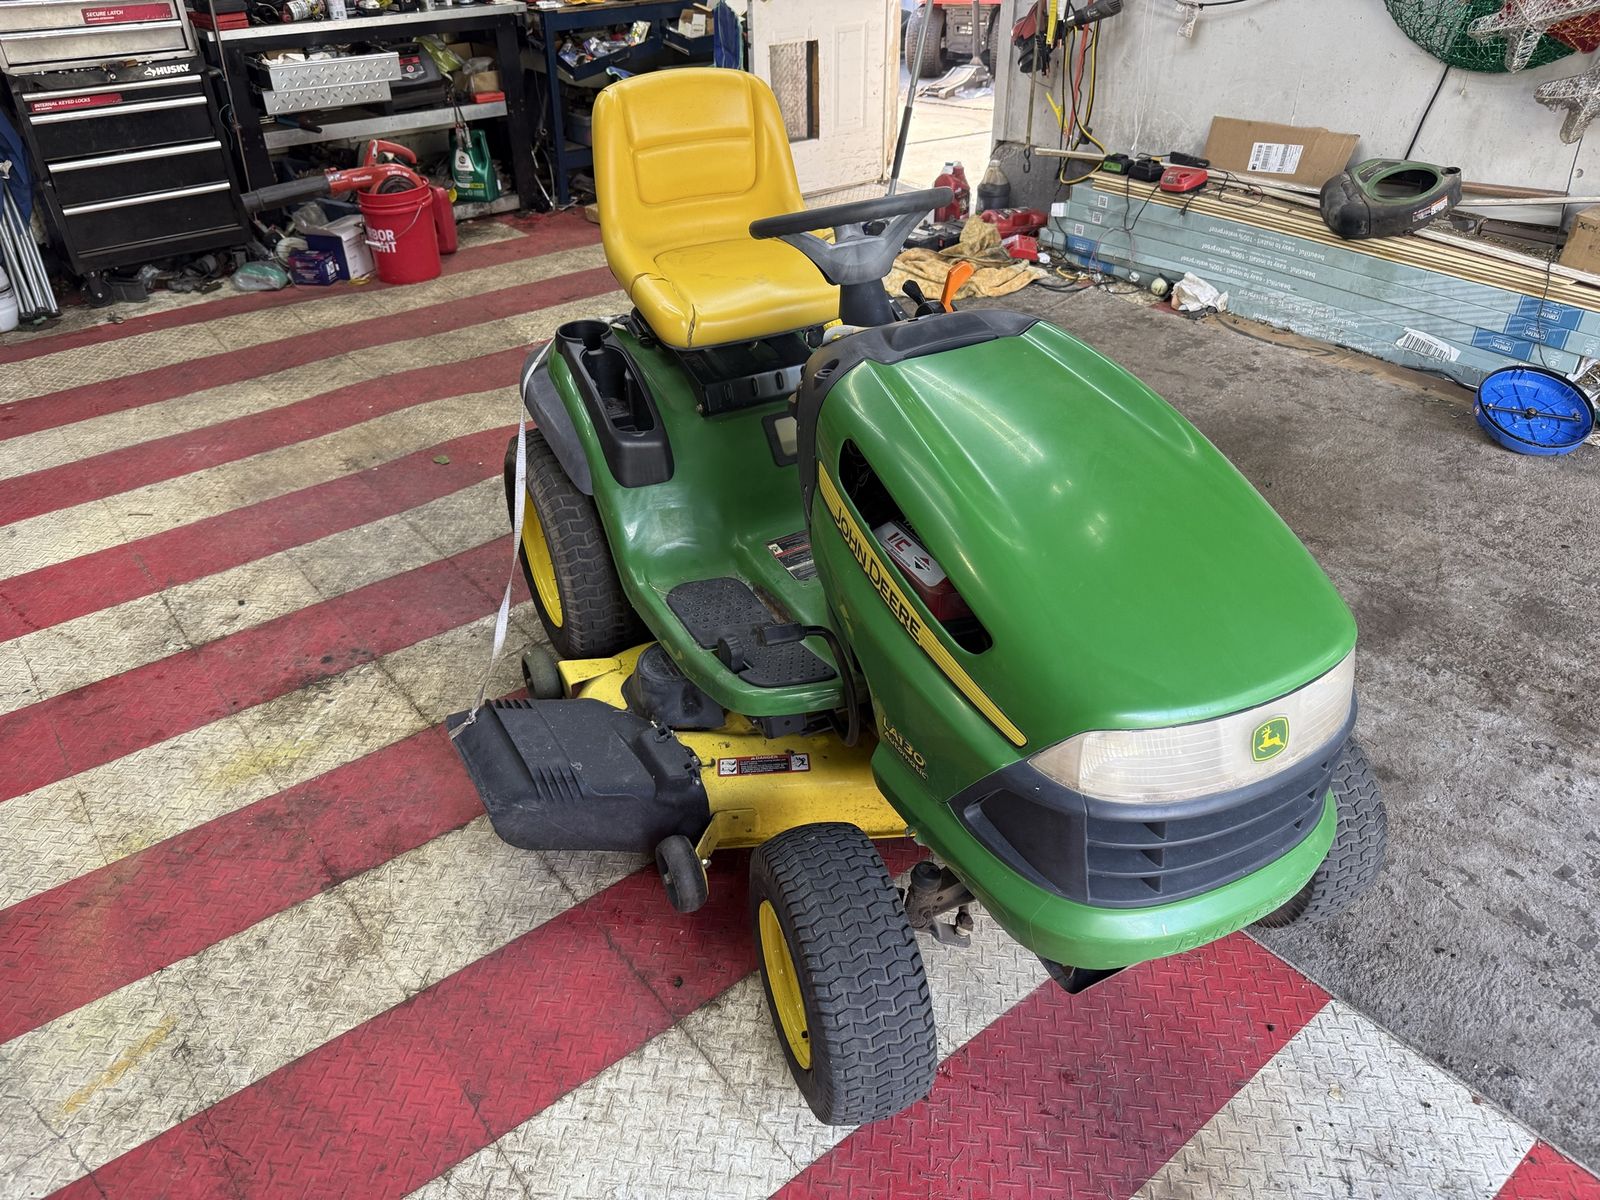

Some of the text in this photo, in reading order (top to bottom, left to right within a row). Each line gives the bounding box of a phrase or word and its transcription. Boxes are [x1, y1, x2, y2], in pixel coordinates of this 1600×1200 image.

[156, 63, 190, 76] HUSKY
[34, 101, 58, 109] INTERNAL
[1208, 226, 1238, 238] waterproof
[1239, 233, 1253, 243] 100%
[1201, 243, 1231, 255] waterproof
[1256, 238, 1275, 248] install
[1281, 243, 1295, 252] easy
[1180, 255, 1209, 267] waterproof
[1248, 255, 1267, 265] install
[1298, 249, 1326, 261] beautiful
[1273, 261, 1287, 270] easy
[1289, 266, 1316, 279] beautiful
[834, 507, 867, 571] JOHN
[868, 556, 921, 642] DEERE
